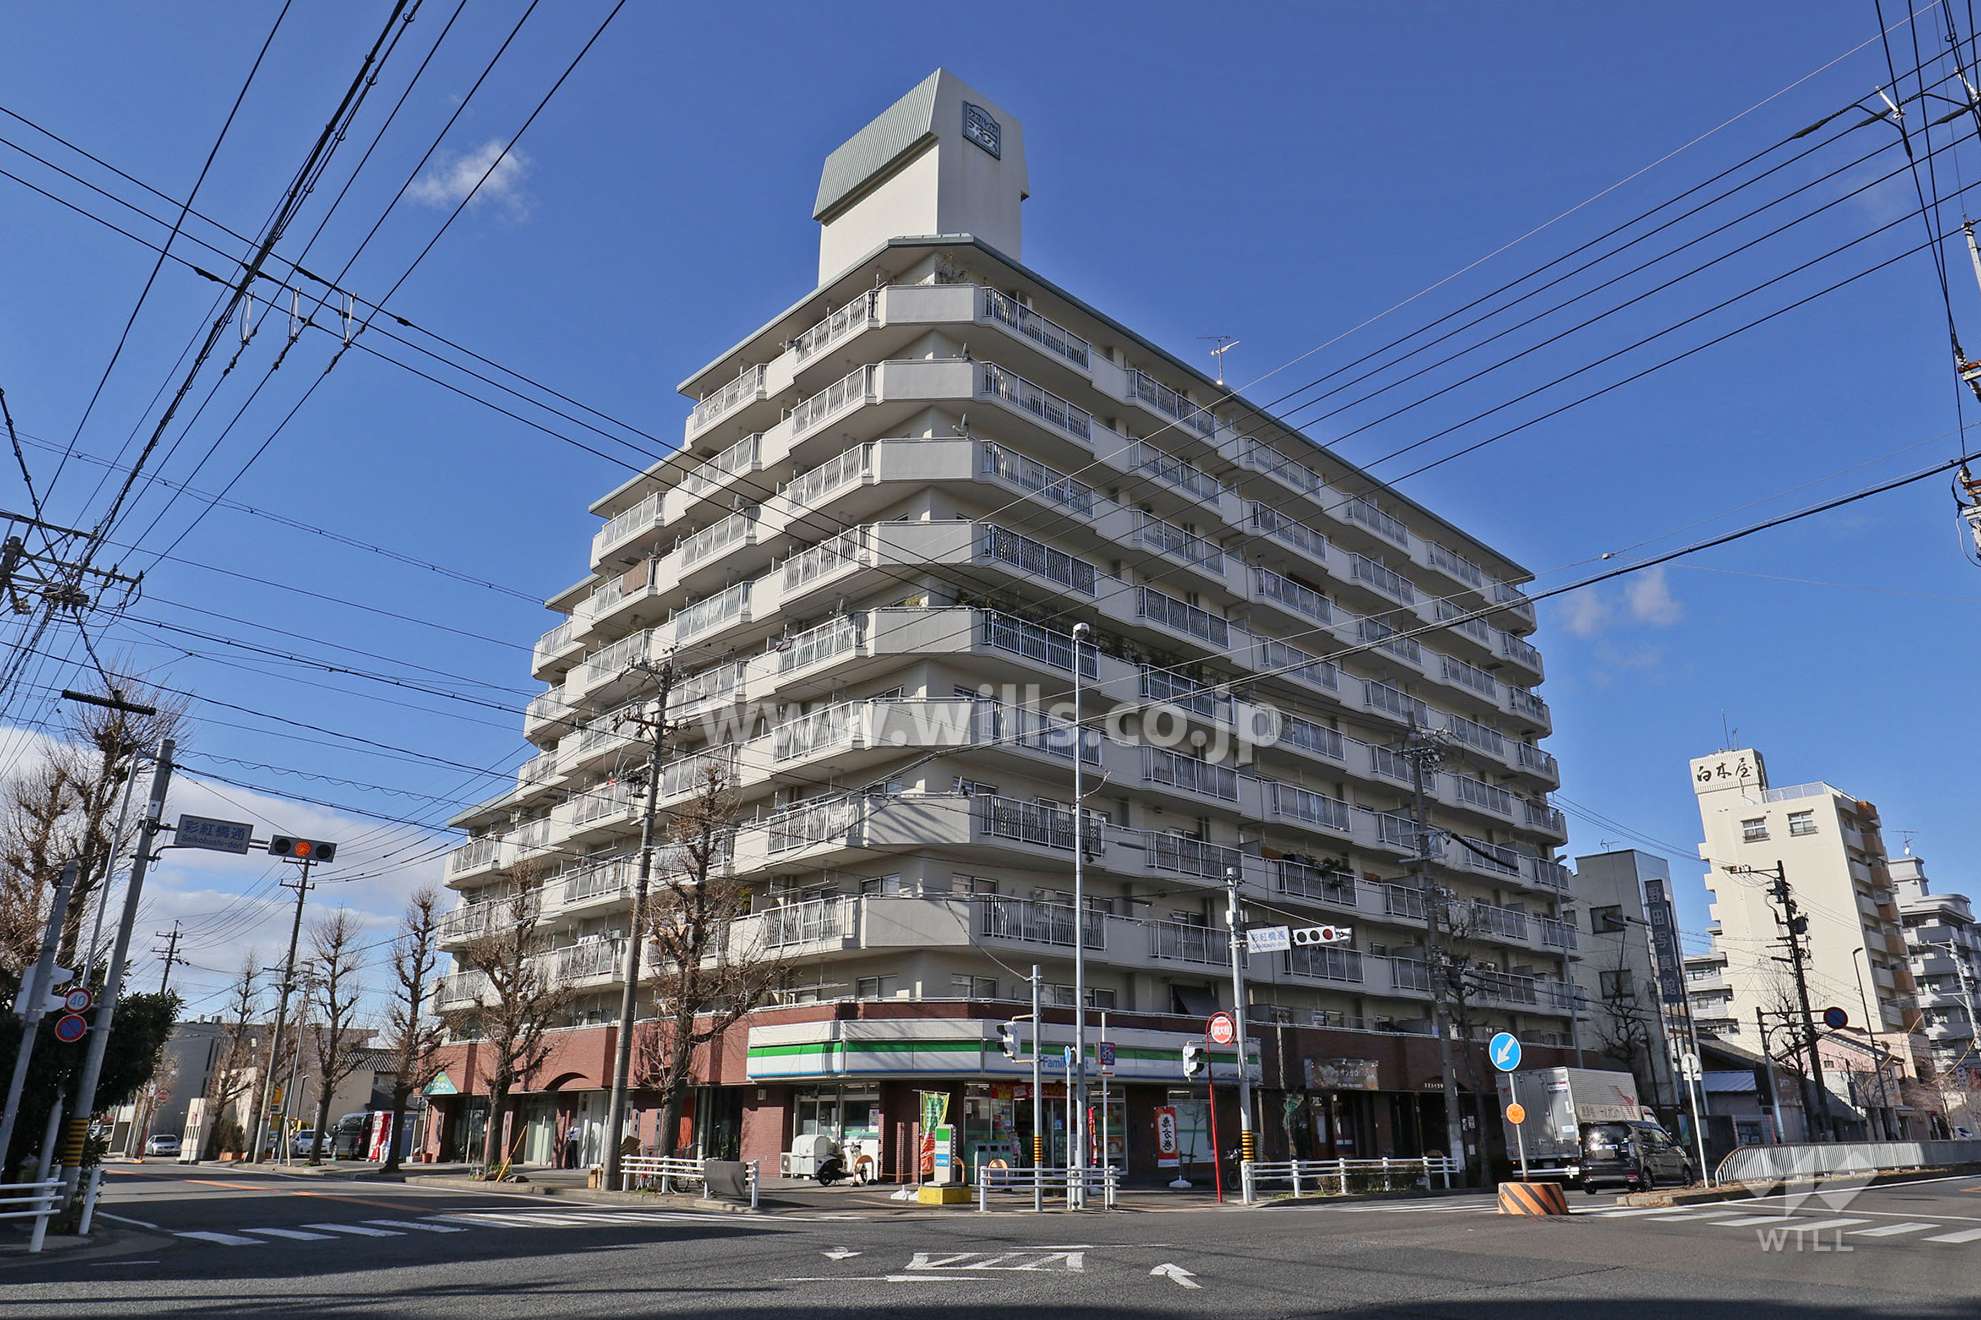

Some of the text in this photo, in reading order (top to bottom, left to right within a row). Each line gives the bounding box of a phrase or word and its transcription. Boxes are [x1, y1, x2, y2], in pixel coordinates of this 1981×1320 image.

[1697, 757, 1752, 781] 白木屋
[71, 995, 86, 1006] 40
